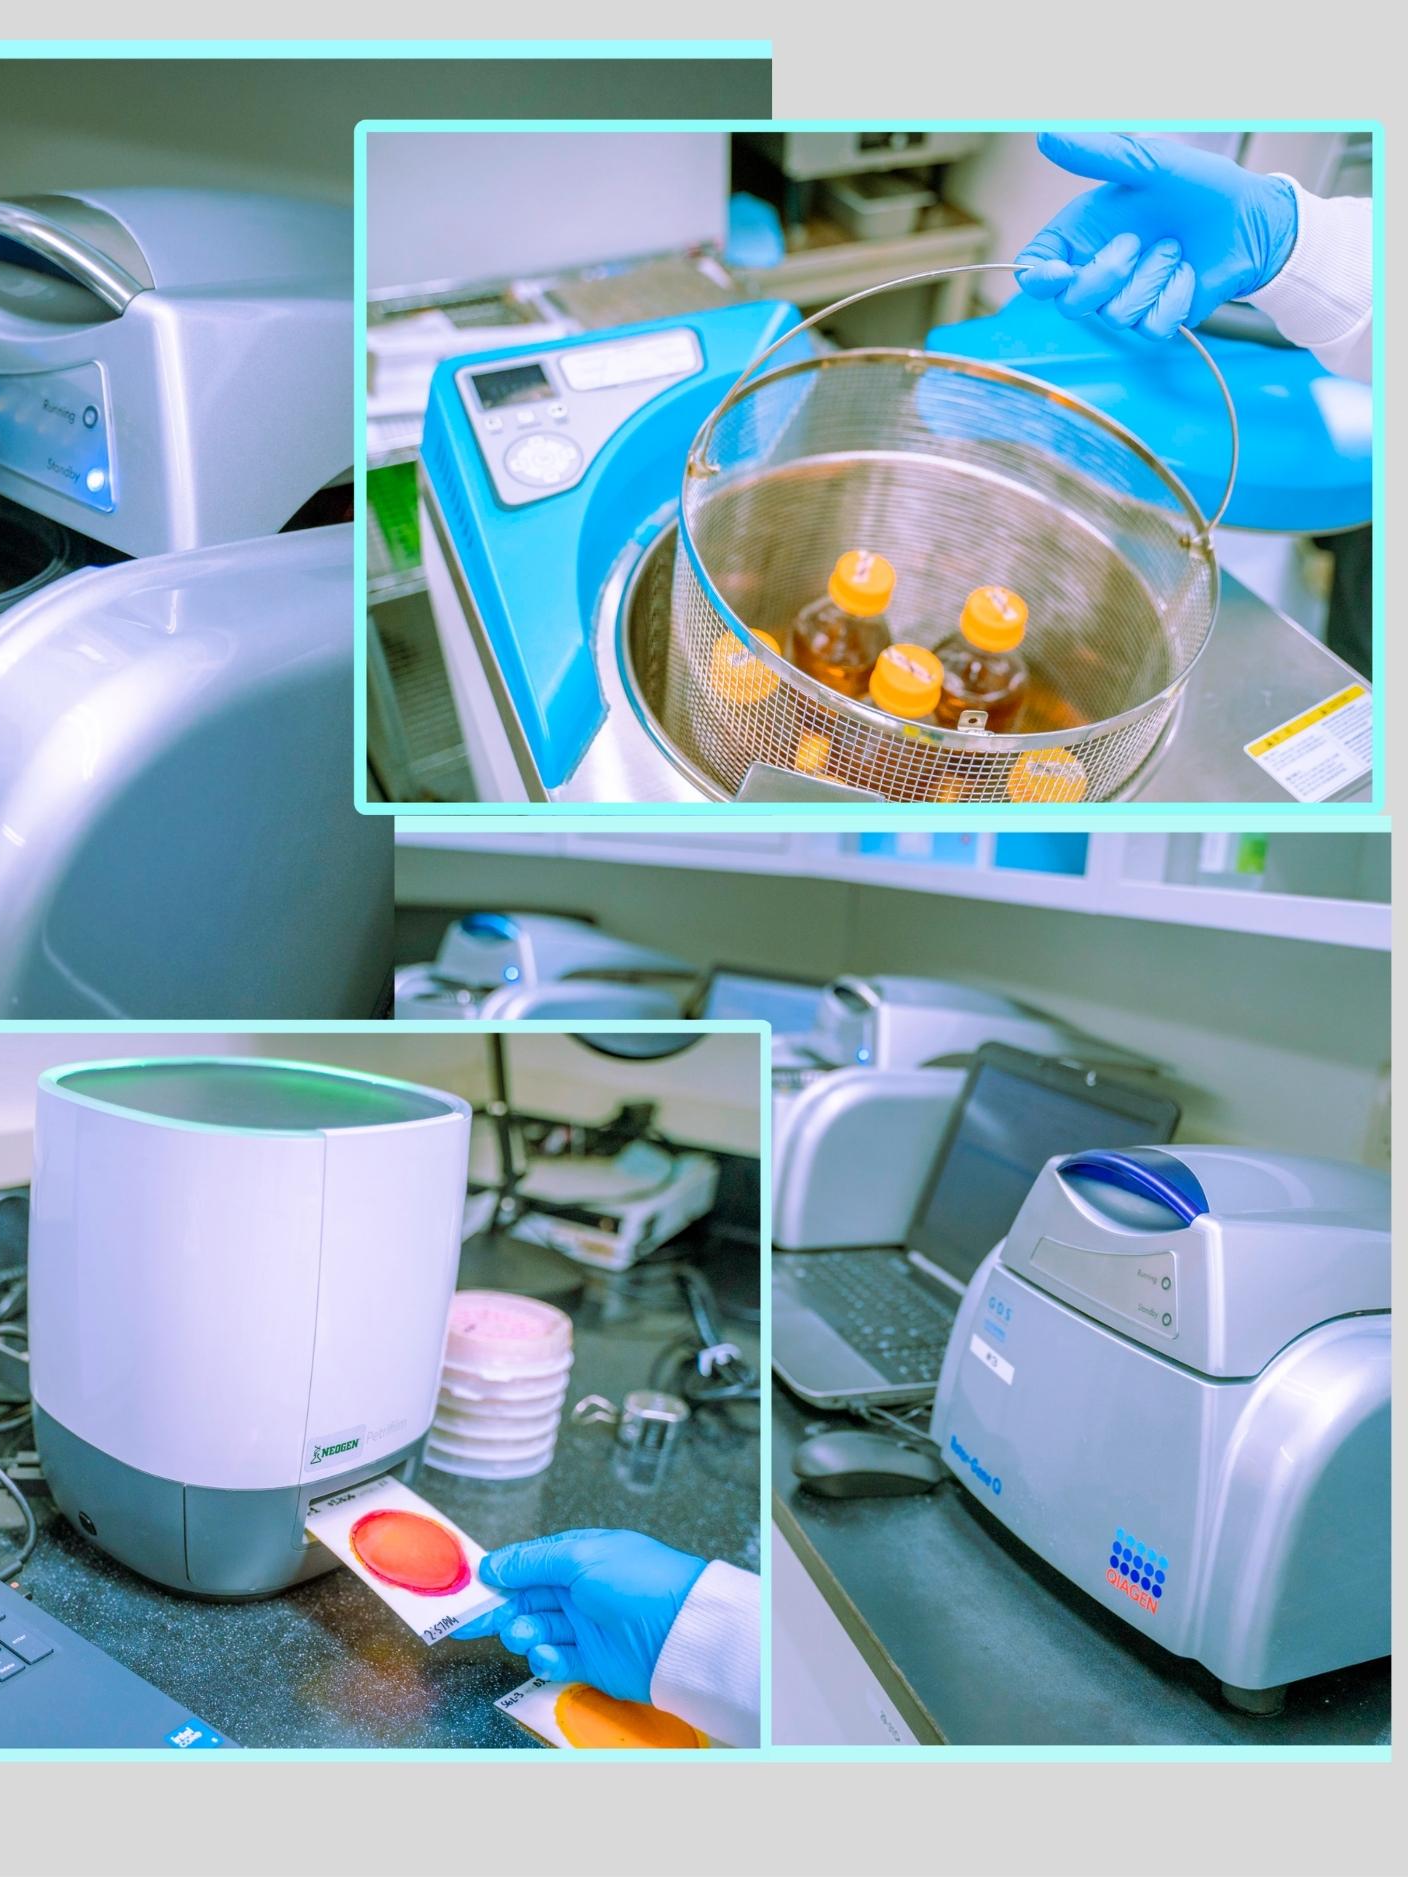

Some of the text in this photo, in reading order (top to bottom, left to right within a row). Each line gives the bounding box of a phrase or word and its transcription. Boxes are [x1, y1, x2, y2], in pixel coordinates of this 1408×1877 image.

[47, 458, 80, 484] Standby
[322, 1438, 360, 1458] NEOGEN
[1106, 1568, 1159, 1616] QIAGEN
